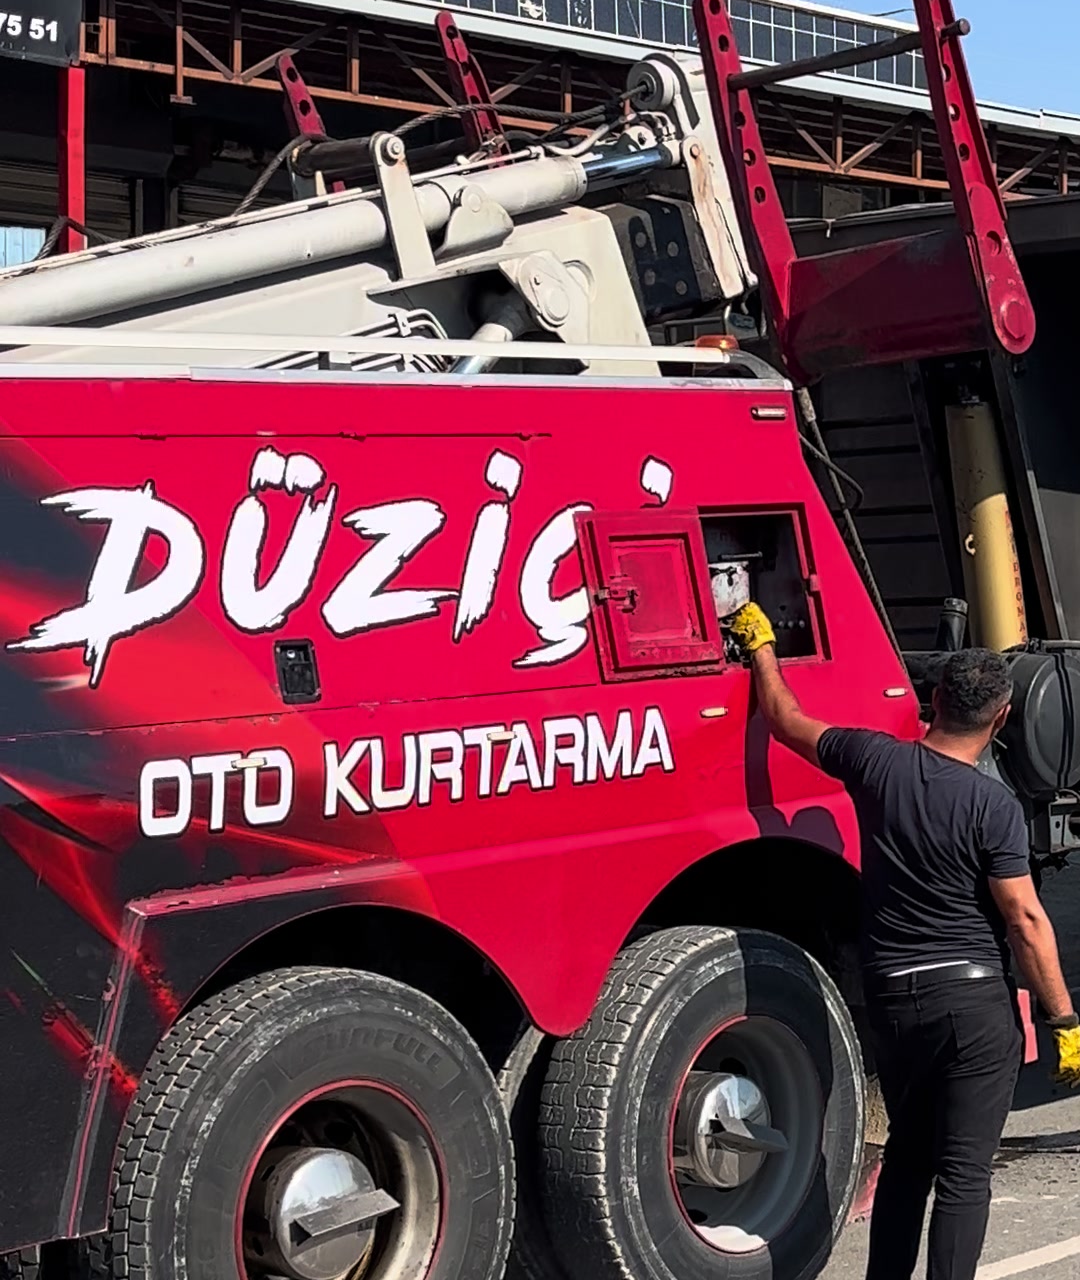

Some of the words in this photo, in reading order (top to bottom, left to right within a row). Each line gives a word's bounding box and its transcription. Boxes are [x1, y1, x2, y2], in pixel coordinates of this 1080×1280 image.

[29, 18, 58, 42] 51
[6, 447, 673, 687] DÜZİÇ
[139, 749, 293, 837] OTO
[325, 707, 674, 818] KURTARMA
